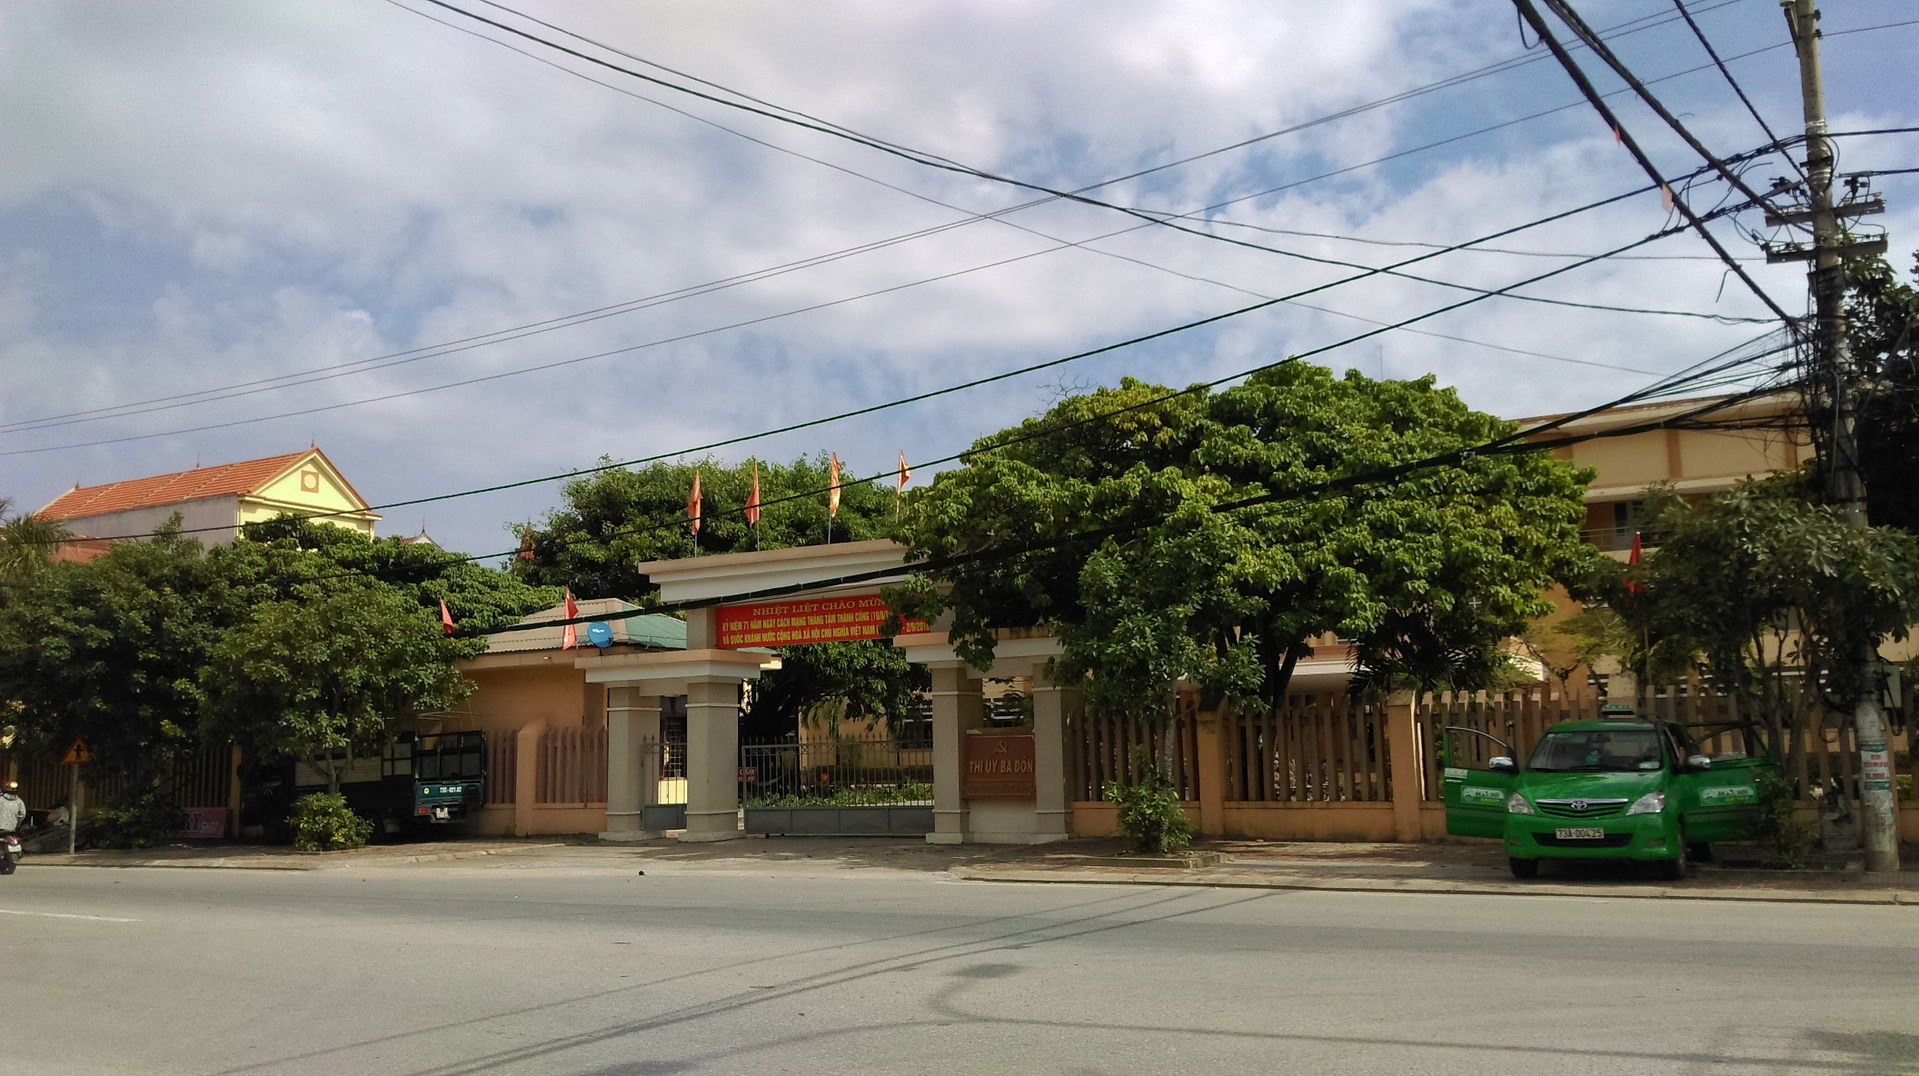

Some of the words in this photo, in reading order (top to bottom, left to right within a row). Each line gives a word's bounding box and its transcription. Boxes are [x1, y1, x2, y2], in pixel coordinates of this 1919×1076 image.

[753, 604, 789, 616] NHIỆT
[792, 602, 819, 613] LIỆT
[822, 599, 856, 610] CHÀO
[859, 597, 886, 607] MỪN
[743, 621, 749, 630] 71
[862, 624, 875, 636] NAM
[1000, 760, 1012, 774] BA
